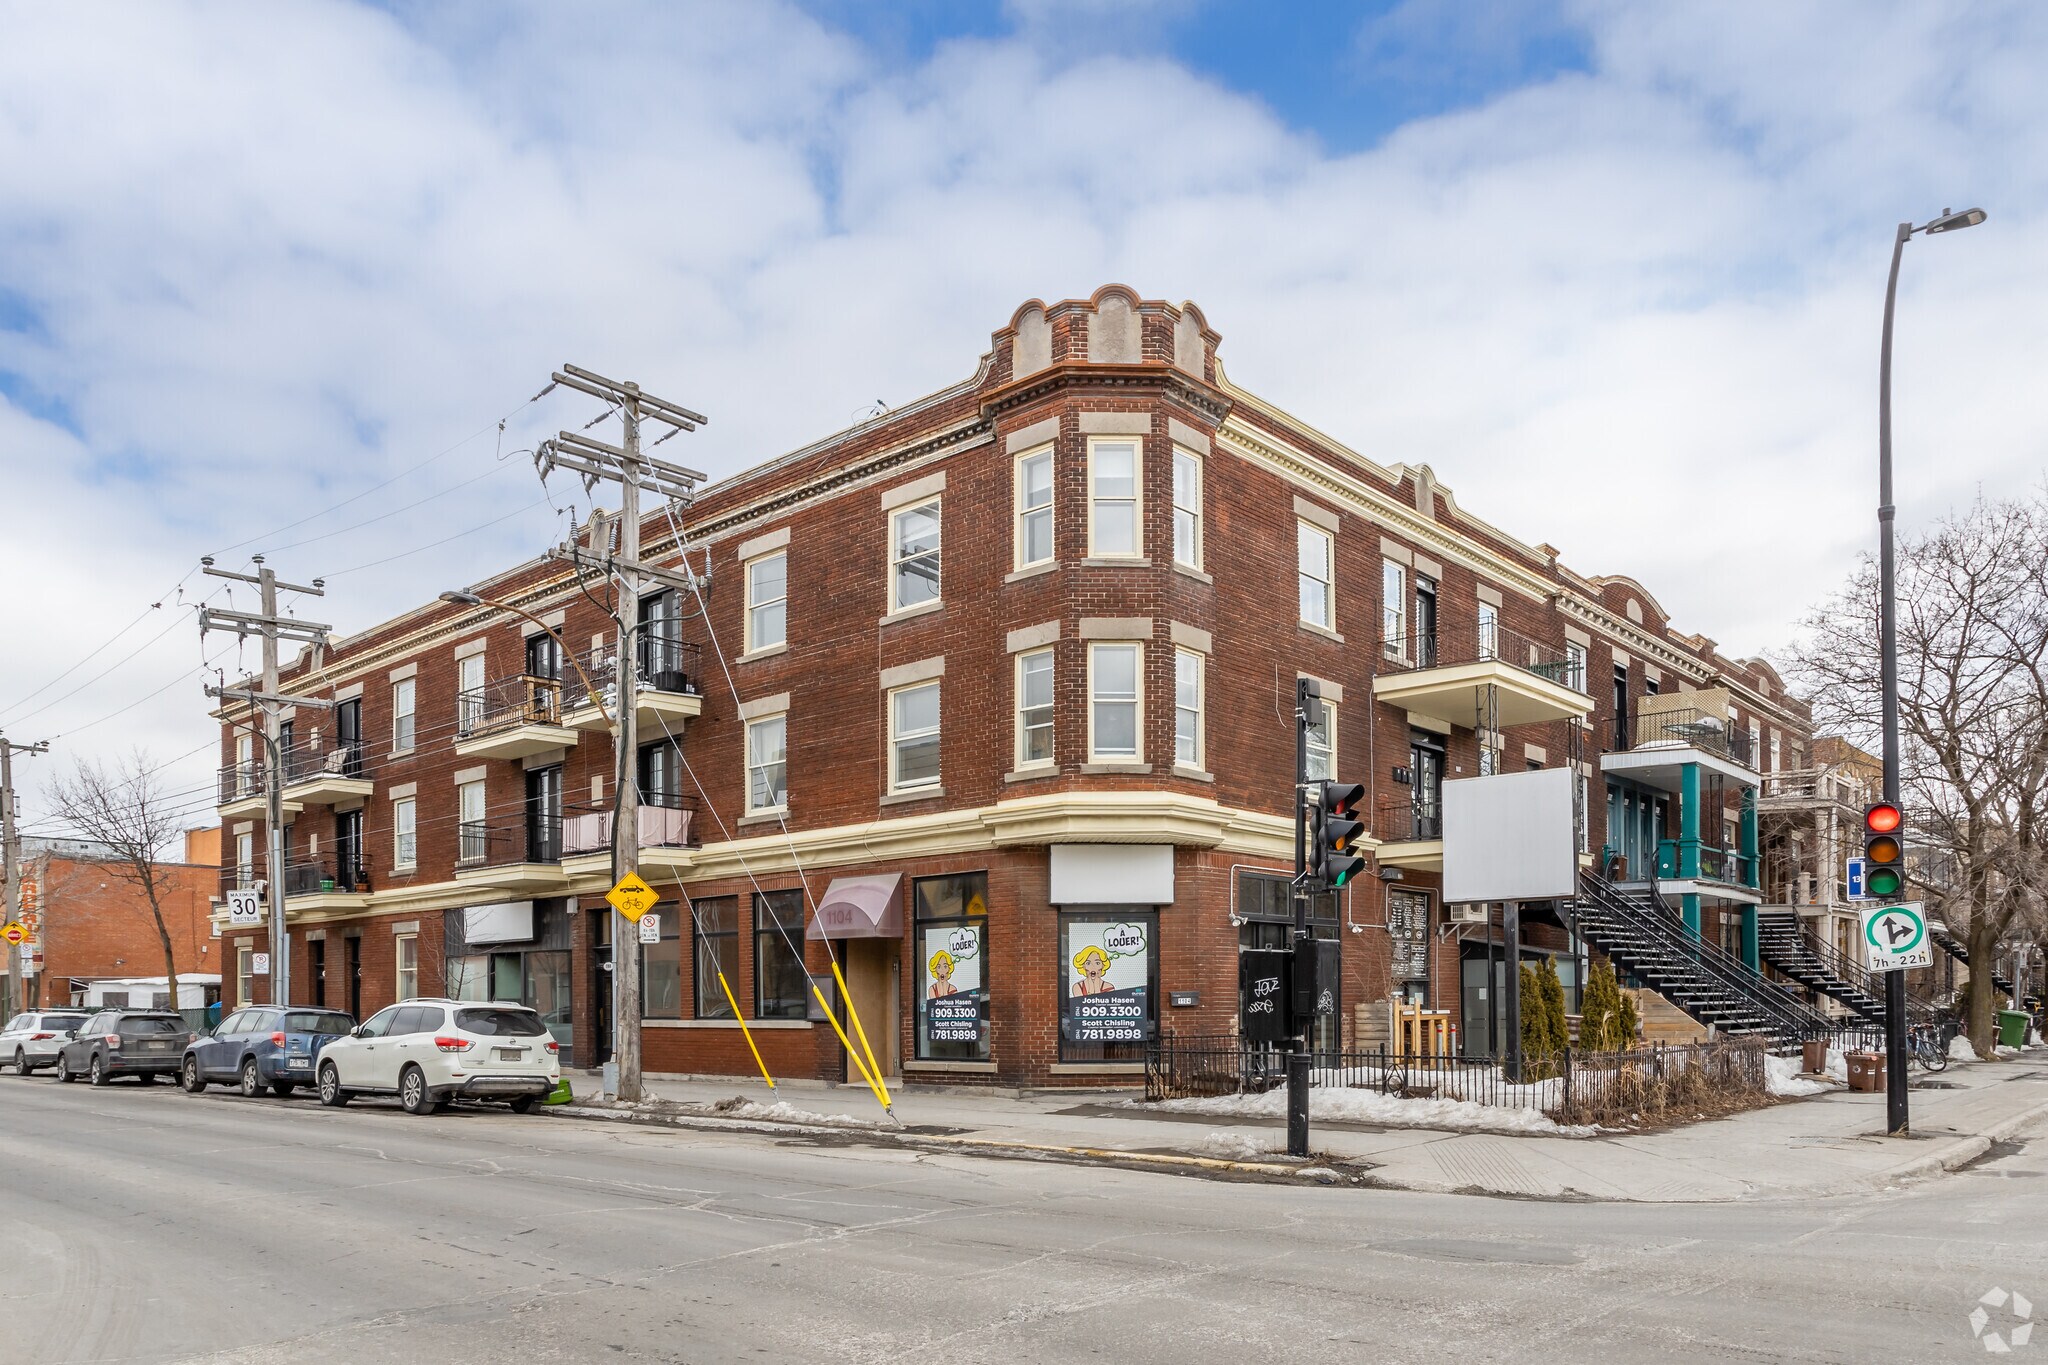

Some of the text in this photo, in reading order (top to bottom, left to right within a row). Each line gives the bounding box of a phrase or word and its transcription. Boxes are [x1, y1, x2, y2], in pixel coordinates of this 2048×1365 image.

[232, 898, 256, 915] 30
[827, 910, 853, 924] 1104
[952, 940, 974, 951] LOUER!
[1108, 936, 1139, 947] LOUER!
[1873, 959, 1889, 968] 7h
[1900, 954, 1926, 965] 22h
[935, 1007, 977, 1018] 909.3300
[1082, 1006, 1142, 1017] 909.3300
[935, 1029, 977, 1040] 781.9898
[1082, 1029, 1142, 1040] 781.9898
